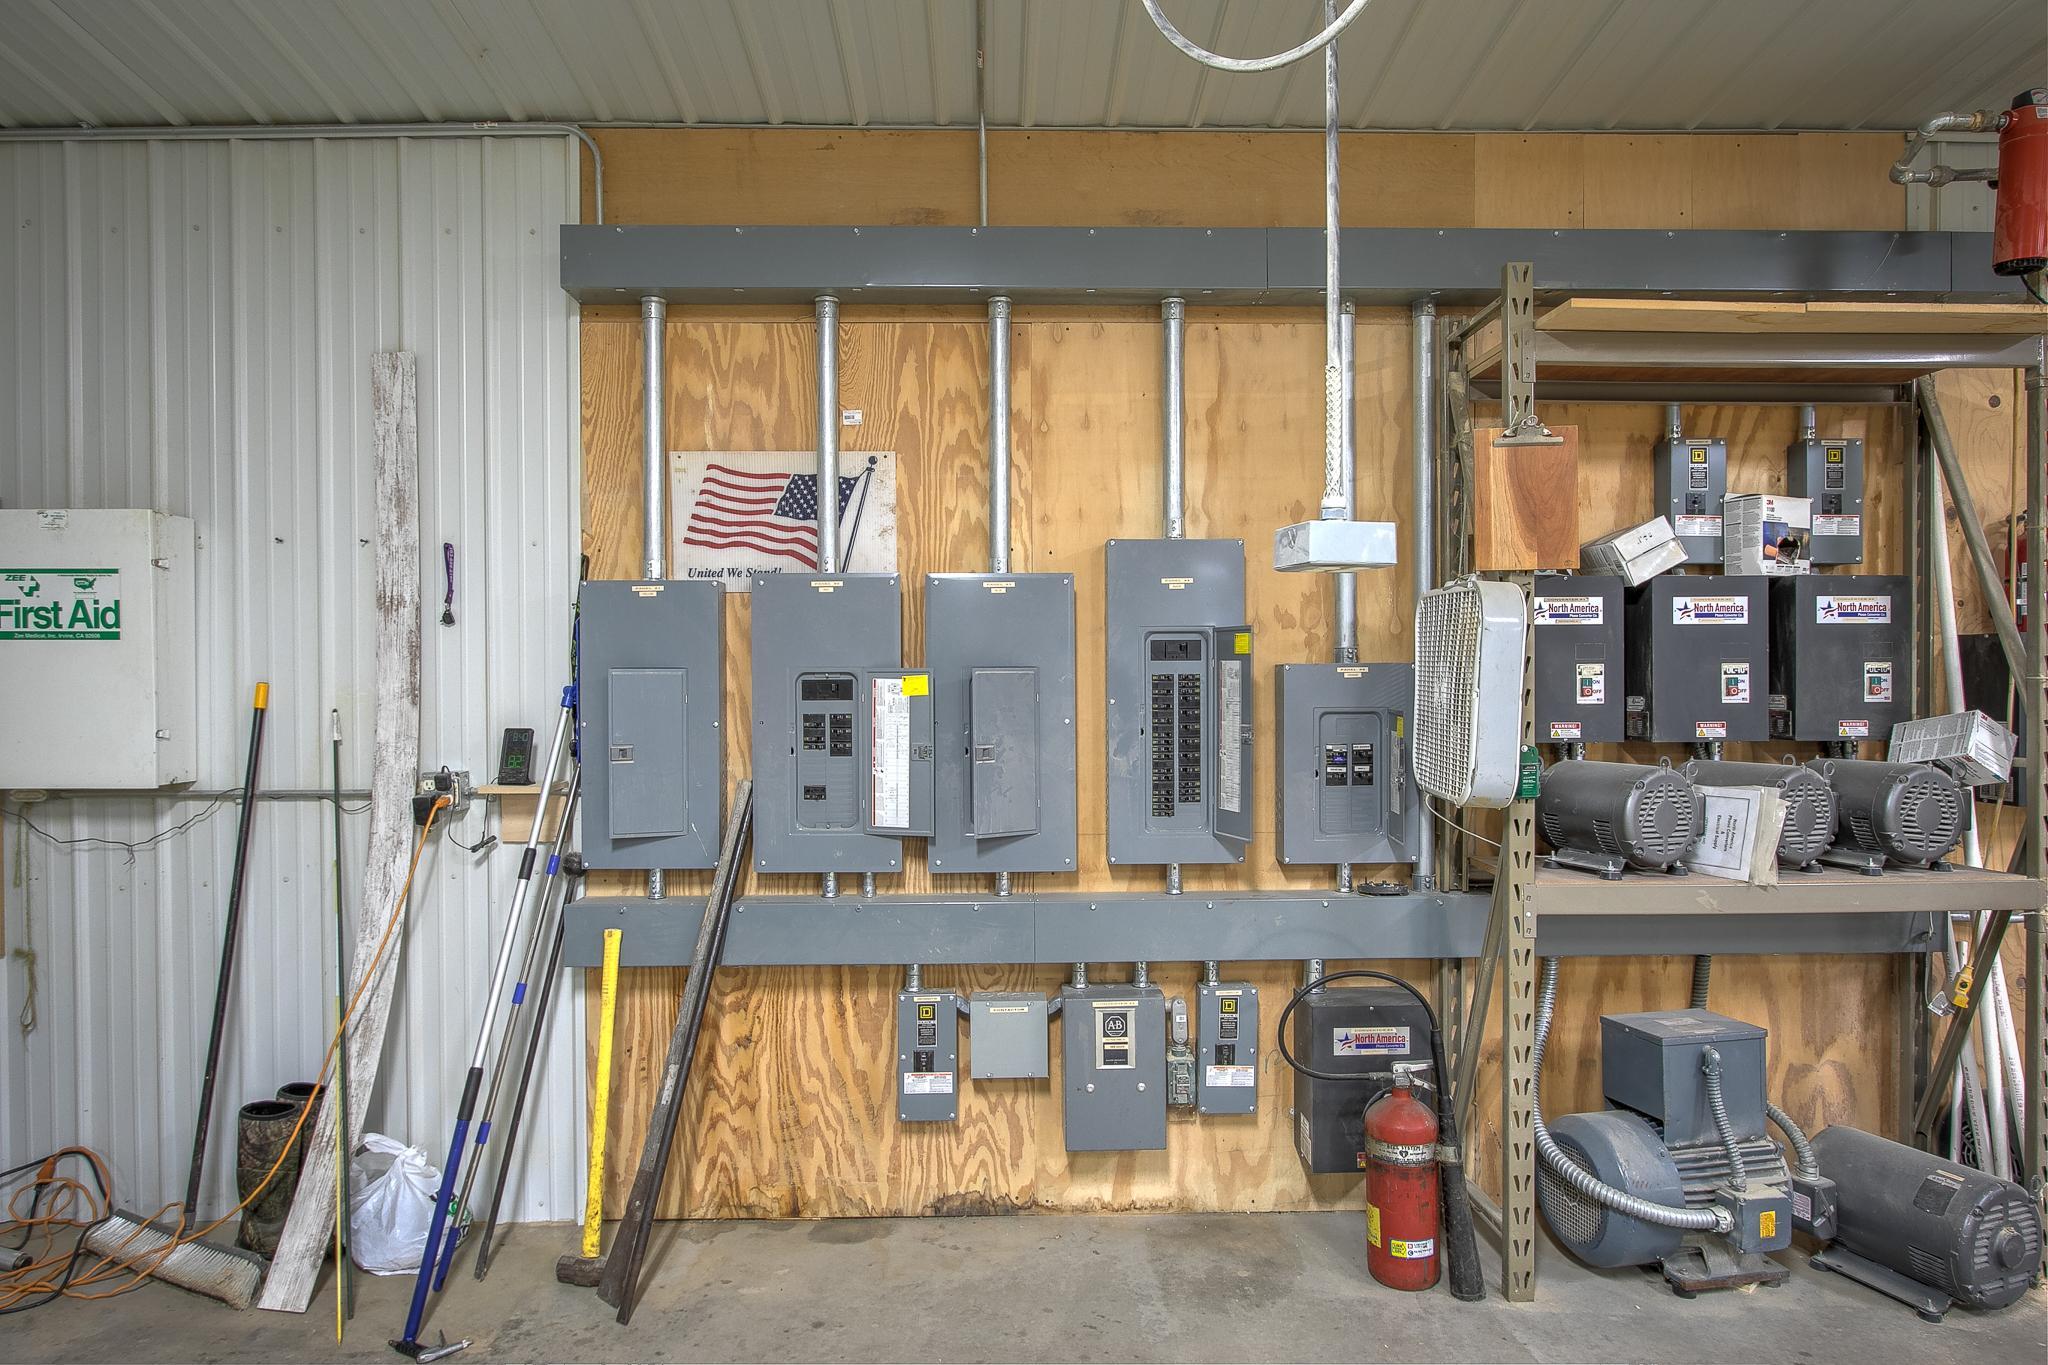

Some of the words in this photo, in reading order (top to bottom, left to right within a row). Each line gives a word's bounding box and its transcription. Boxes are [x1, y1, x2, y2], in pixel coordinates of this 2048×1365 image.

[688, 568, 724, 578] United
[727, 568, 743, 578] We
[1549, 603, 1568, 612] North
[1570, 603, 1599, 612] America
[1694, 603, 1714, 612] North
[1715, 602, 1744, 612] America
[1837, 602, 1857, 611] North
[1858, 602, 1887, 611] America
[0, 599, 63, 629] First
[68, 599, 120, 629] Aid
[1355, 1033, 1374, 1043] North
[1376, 1032, 1406, 1043] America
